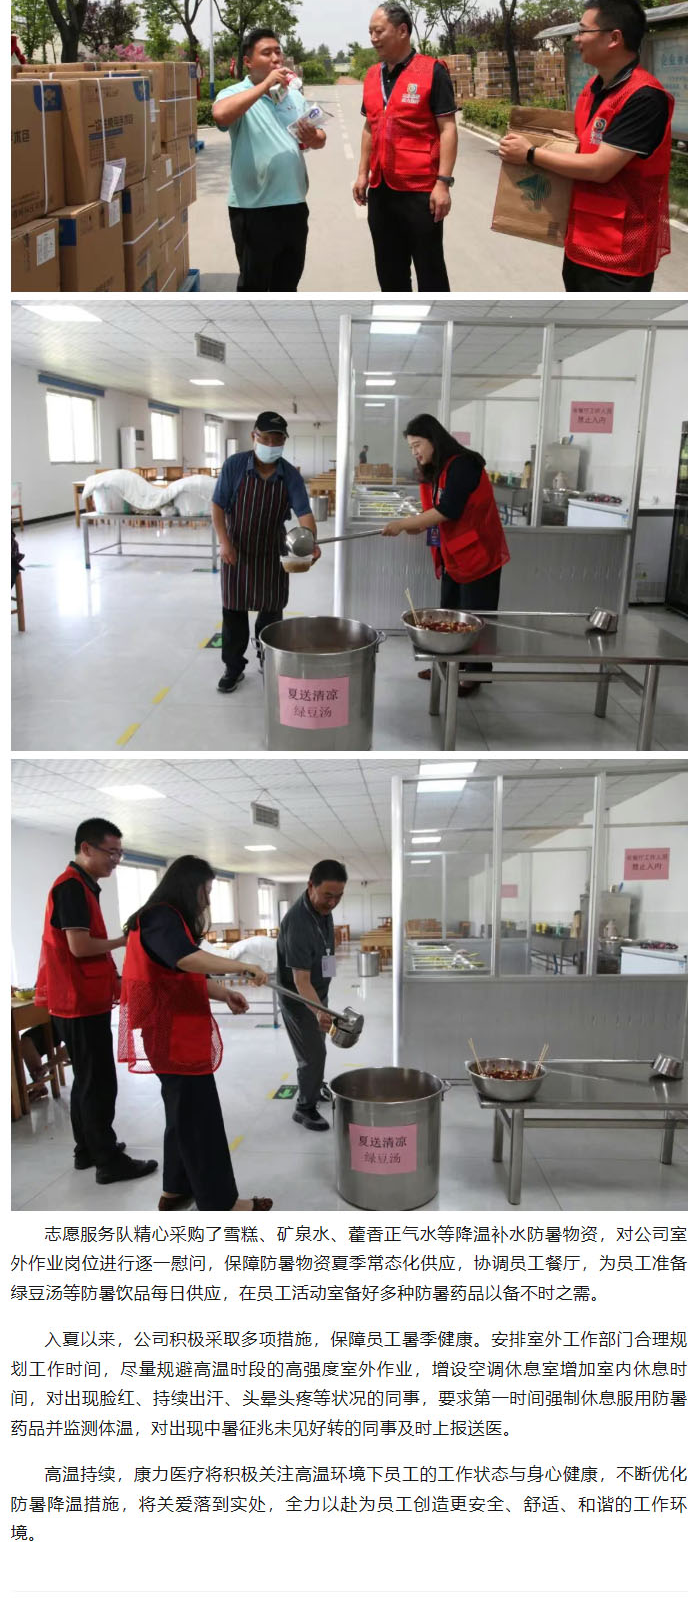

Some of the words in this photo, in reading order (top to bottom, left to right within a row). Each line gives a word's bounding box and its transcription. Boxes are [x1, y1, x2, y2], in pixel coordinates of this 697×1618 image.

[577, 415, 607, 425] 禁止入内
[287, 687, 339, 701] 夏送清凉
[293, 705, 333, 719] 绿豆汤
[632, 862, 662, 871] 禁止入内
[358, 1135, 408, 1149] 夏送清凉
[364, 1151, 401, 1164] 绿豆汤
